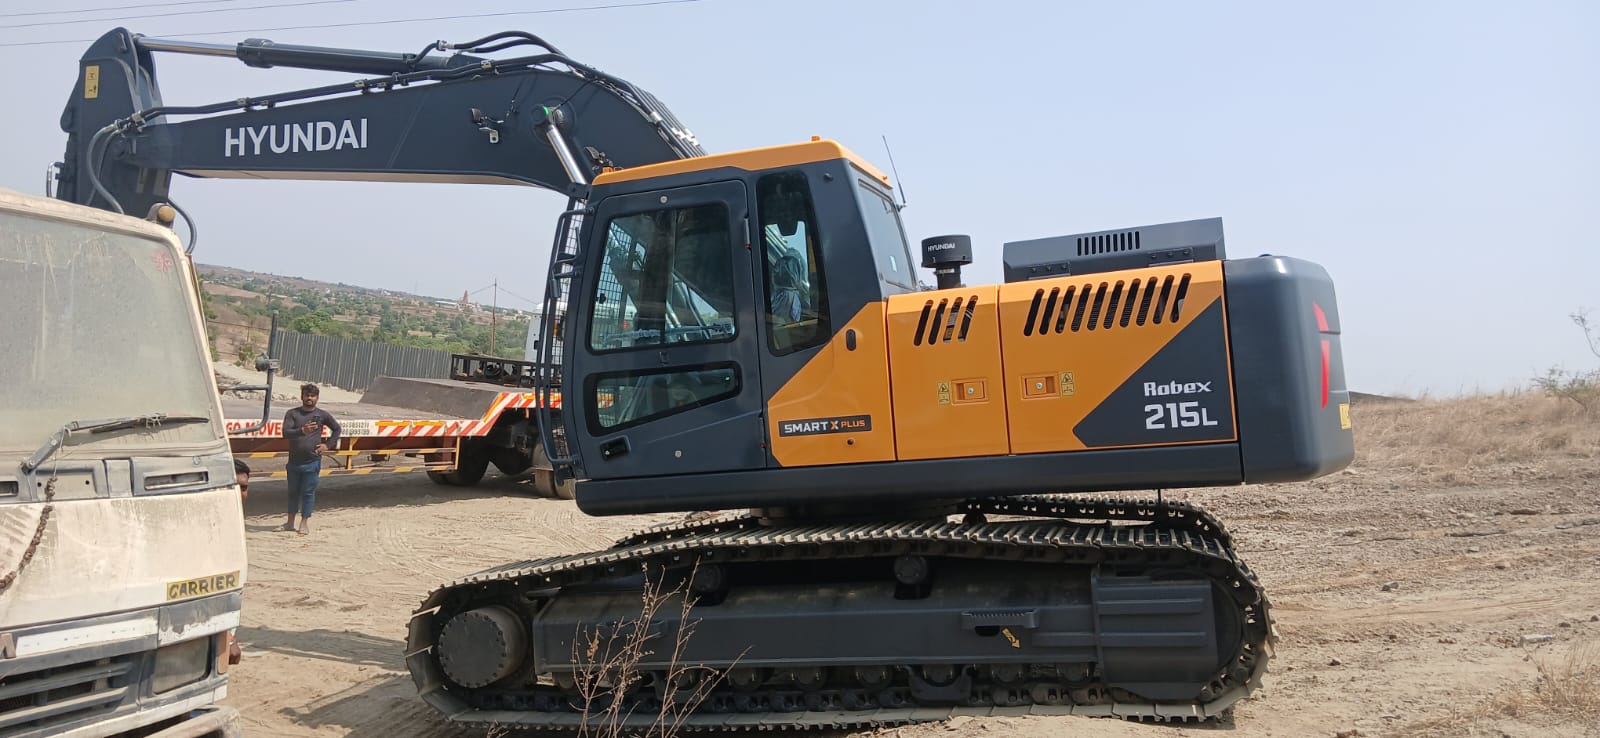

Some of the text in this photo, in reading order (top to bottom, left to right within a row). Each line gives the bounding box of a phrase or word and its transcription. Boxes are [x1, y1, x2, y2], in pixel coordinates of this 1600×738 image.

[224, 118, 368, 157] HYUNDAI
[927, 242, 956, 252] HYUNDAI
[1143, 380, 1213, 397] Robex
[1144, 401, 1218, 429] 215L
[784, 419, 866, 433] SMART X PLUS
[169, 574, 236, 599] CARRIER
